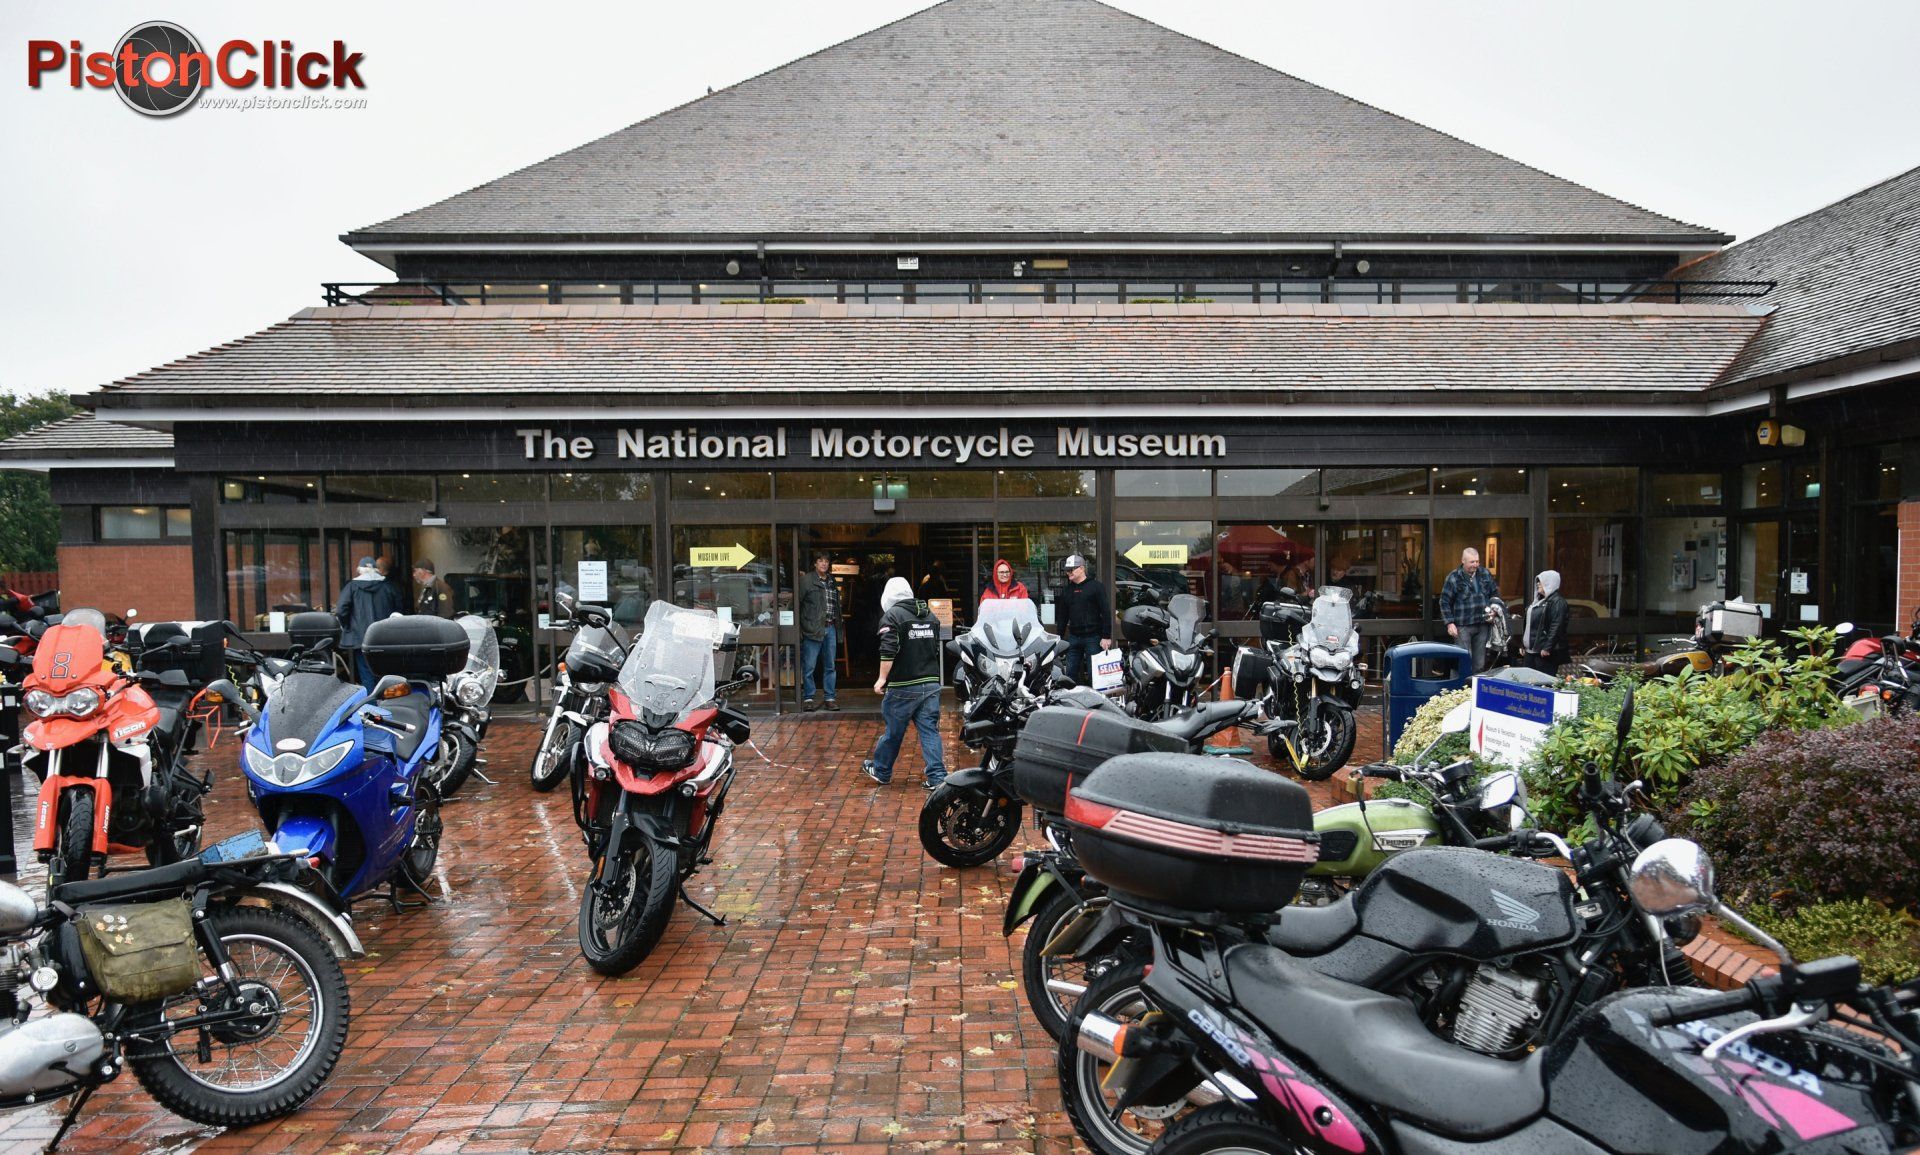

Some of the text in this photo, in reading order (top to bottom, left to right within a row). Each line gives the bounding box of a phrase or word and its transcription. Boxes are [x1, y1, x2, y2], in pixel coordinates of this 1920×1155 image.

[516, 427, 1227, 463] The National Motorcycle Museum
[697, 552, 730, 561] MUSEUM LIVE
[1148, 550, 1180, 559] MUSEUM LIVE
[51, 653, 71, 678] 8
[1481, 683, 1547, 705] The National Motorcycle Museum
[1380, 837, 1417, 848] TRIUMPH
[1486, 918, 1540, 933] HONDA
[1187, 1008, 1252, 1068] CB500
[1676, 1019, 1823, 1096] HONDA
